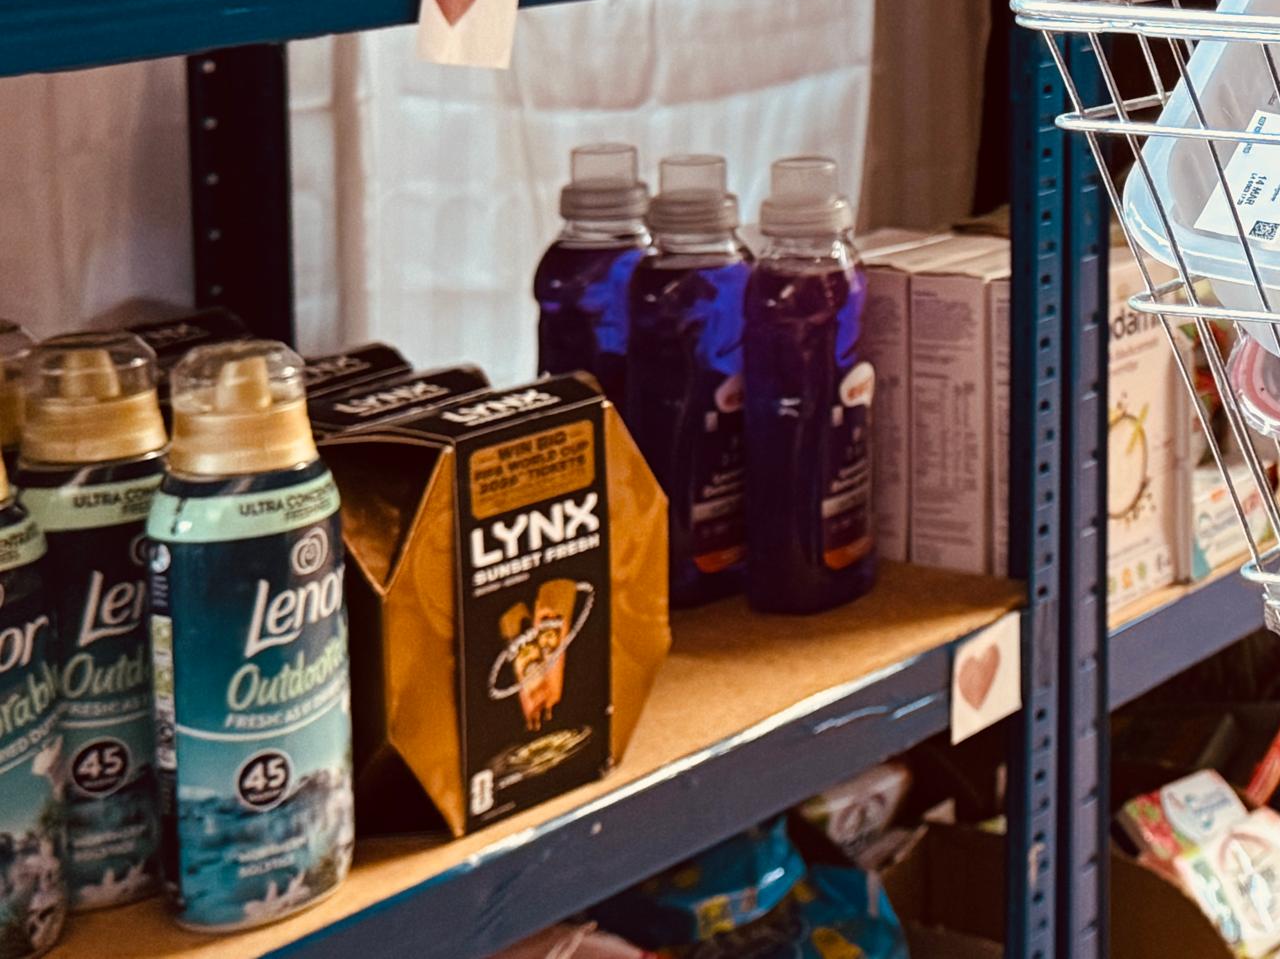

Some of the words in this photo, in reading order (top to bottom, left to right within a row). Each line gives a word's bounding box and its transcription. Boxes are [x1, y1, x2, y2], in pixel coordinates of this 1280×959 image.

[1244, 185, 1262, 208] MAR
[441, 389, 561, 427] LYNX
[73, 493, 121, 508] ULTRA
[240, 500, 284, 516] ULTRA
[471, 492, 600, 568] LYNX
[472, 551, 542, 586] SUNSET
[544, 533, 600, 563] FRESH
[77, 746, 125, 779] 45
[242, 756, 286, 790] 45
